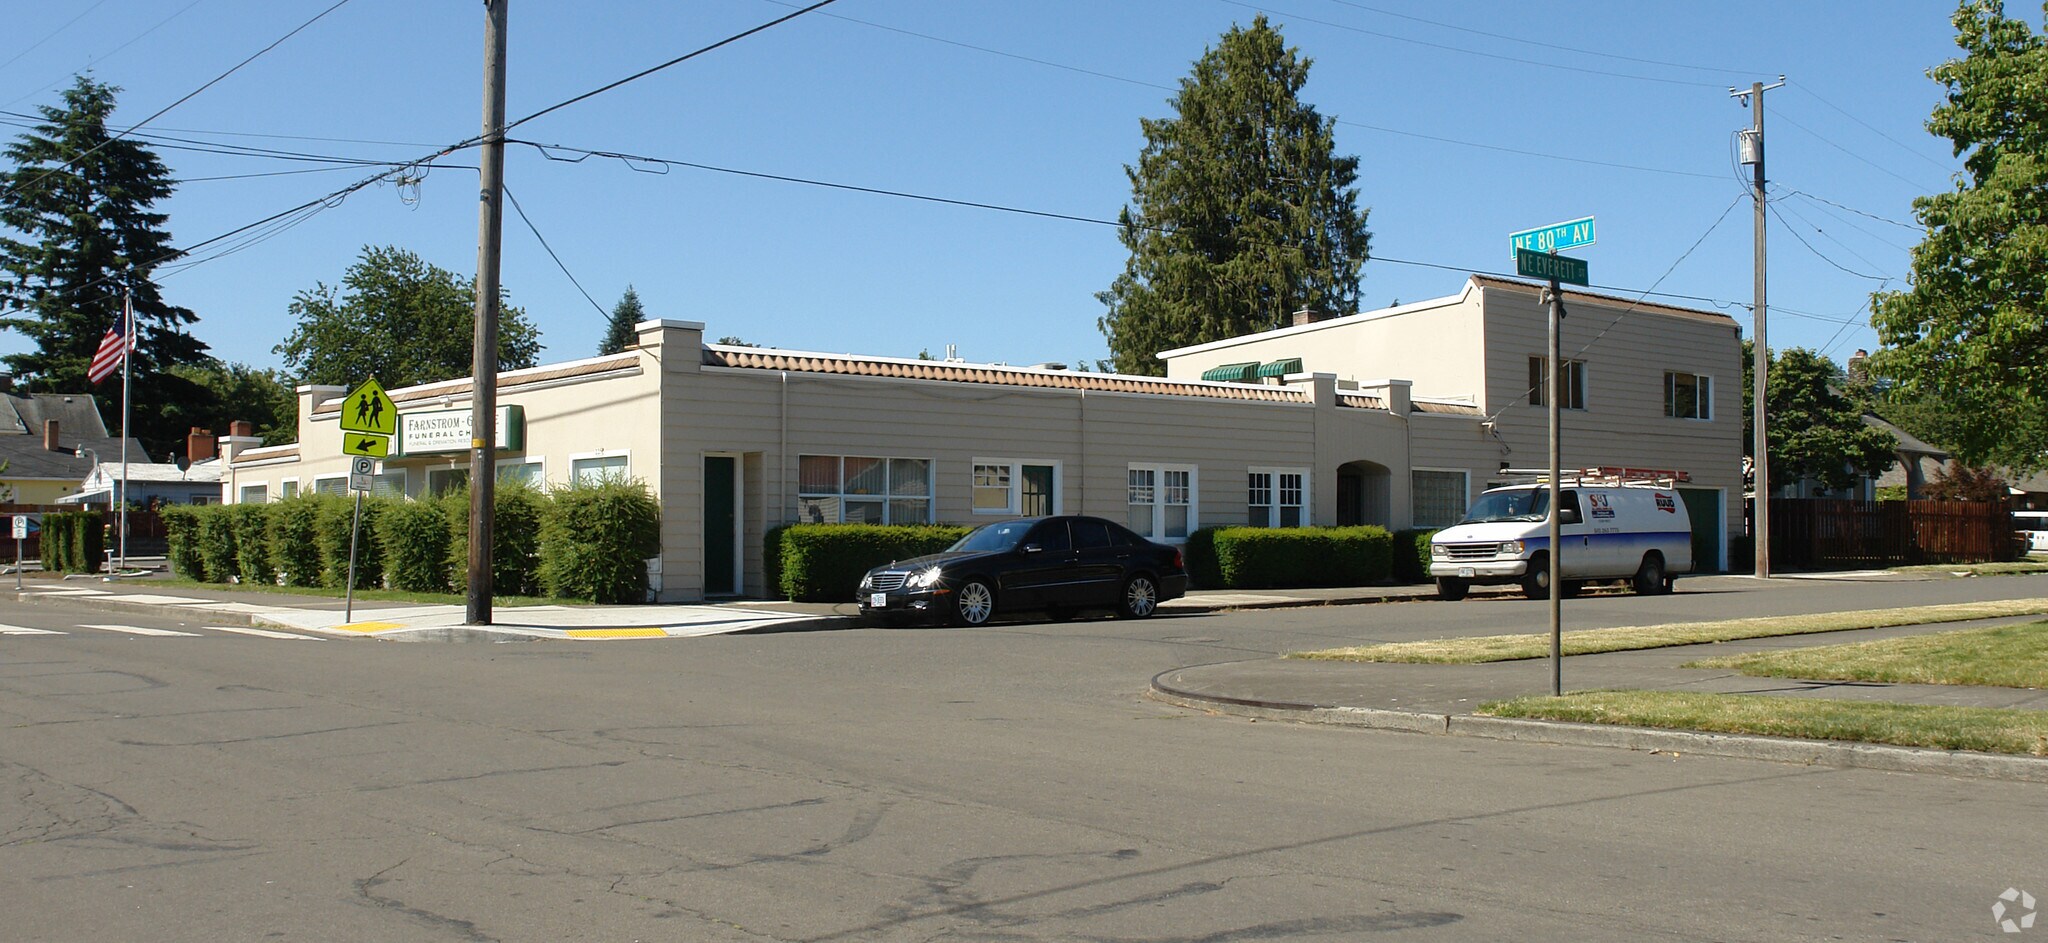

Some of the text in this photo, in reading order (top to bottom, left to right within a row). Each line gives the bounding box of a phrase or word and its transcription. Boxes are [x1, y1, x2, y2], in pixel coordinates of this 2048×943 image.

[1573, 222, 1590, 243] AV
[1521, 253, 1534, 272] NE
[1537, 256, 1575, 280] EVERETT
[409, 430, 454, 439] FUNERAL
